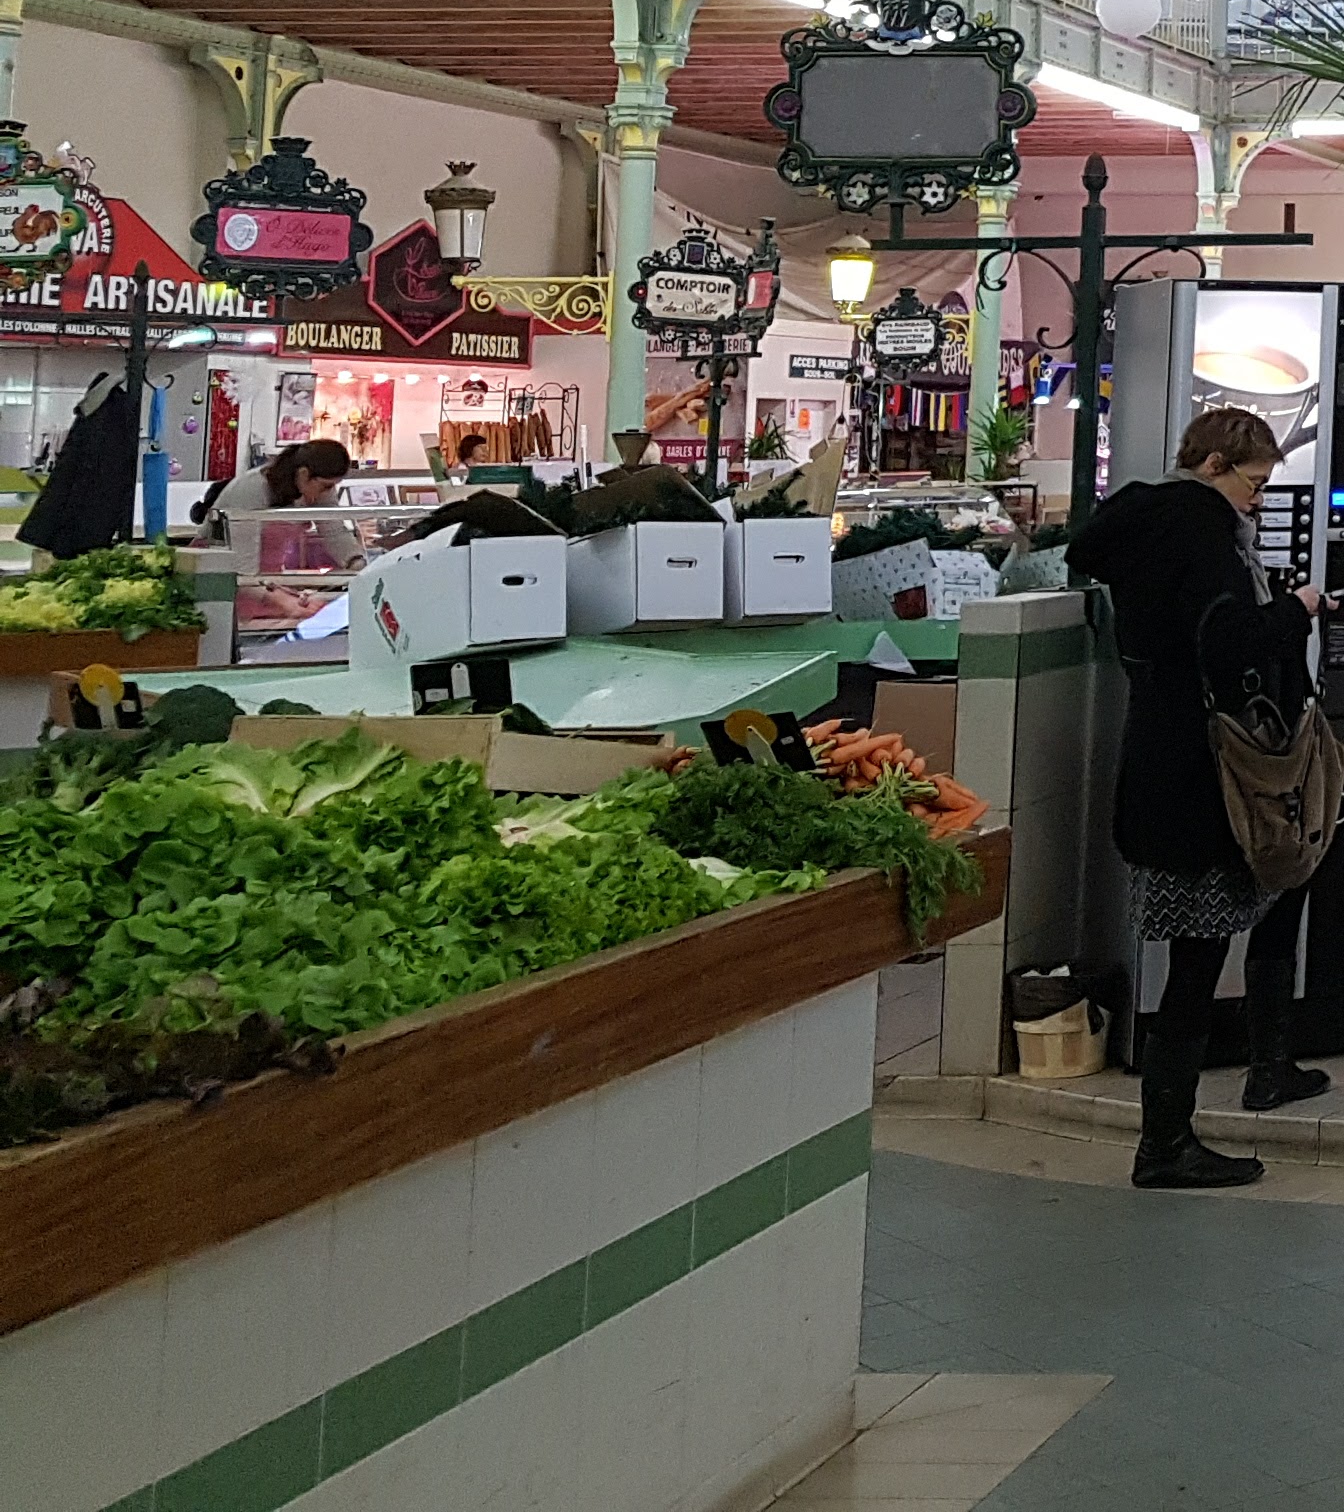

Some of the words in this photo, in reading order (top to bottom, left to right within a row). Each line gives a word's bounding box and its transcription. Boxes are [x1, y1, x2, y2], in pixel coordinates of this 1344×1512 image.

[74, 188, 111, 254] ARCUTERIE
[84, 274, 268, 318] ARISANALE
[656, 278, 732, 294] COMPTOIR
[286, 322, 382, 350] BOULANGER
[451, 332, 519, 359] PATISSIER
[792, 356, 817, 369] ACCES
[819, 358, 849, 371] PARKING
